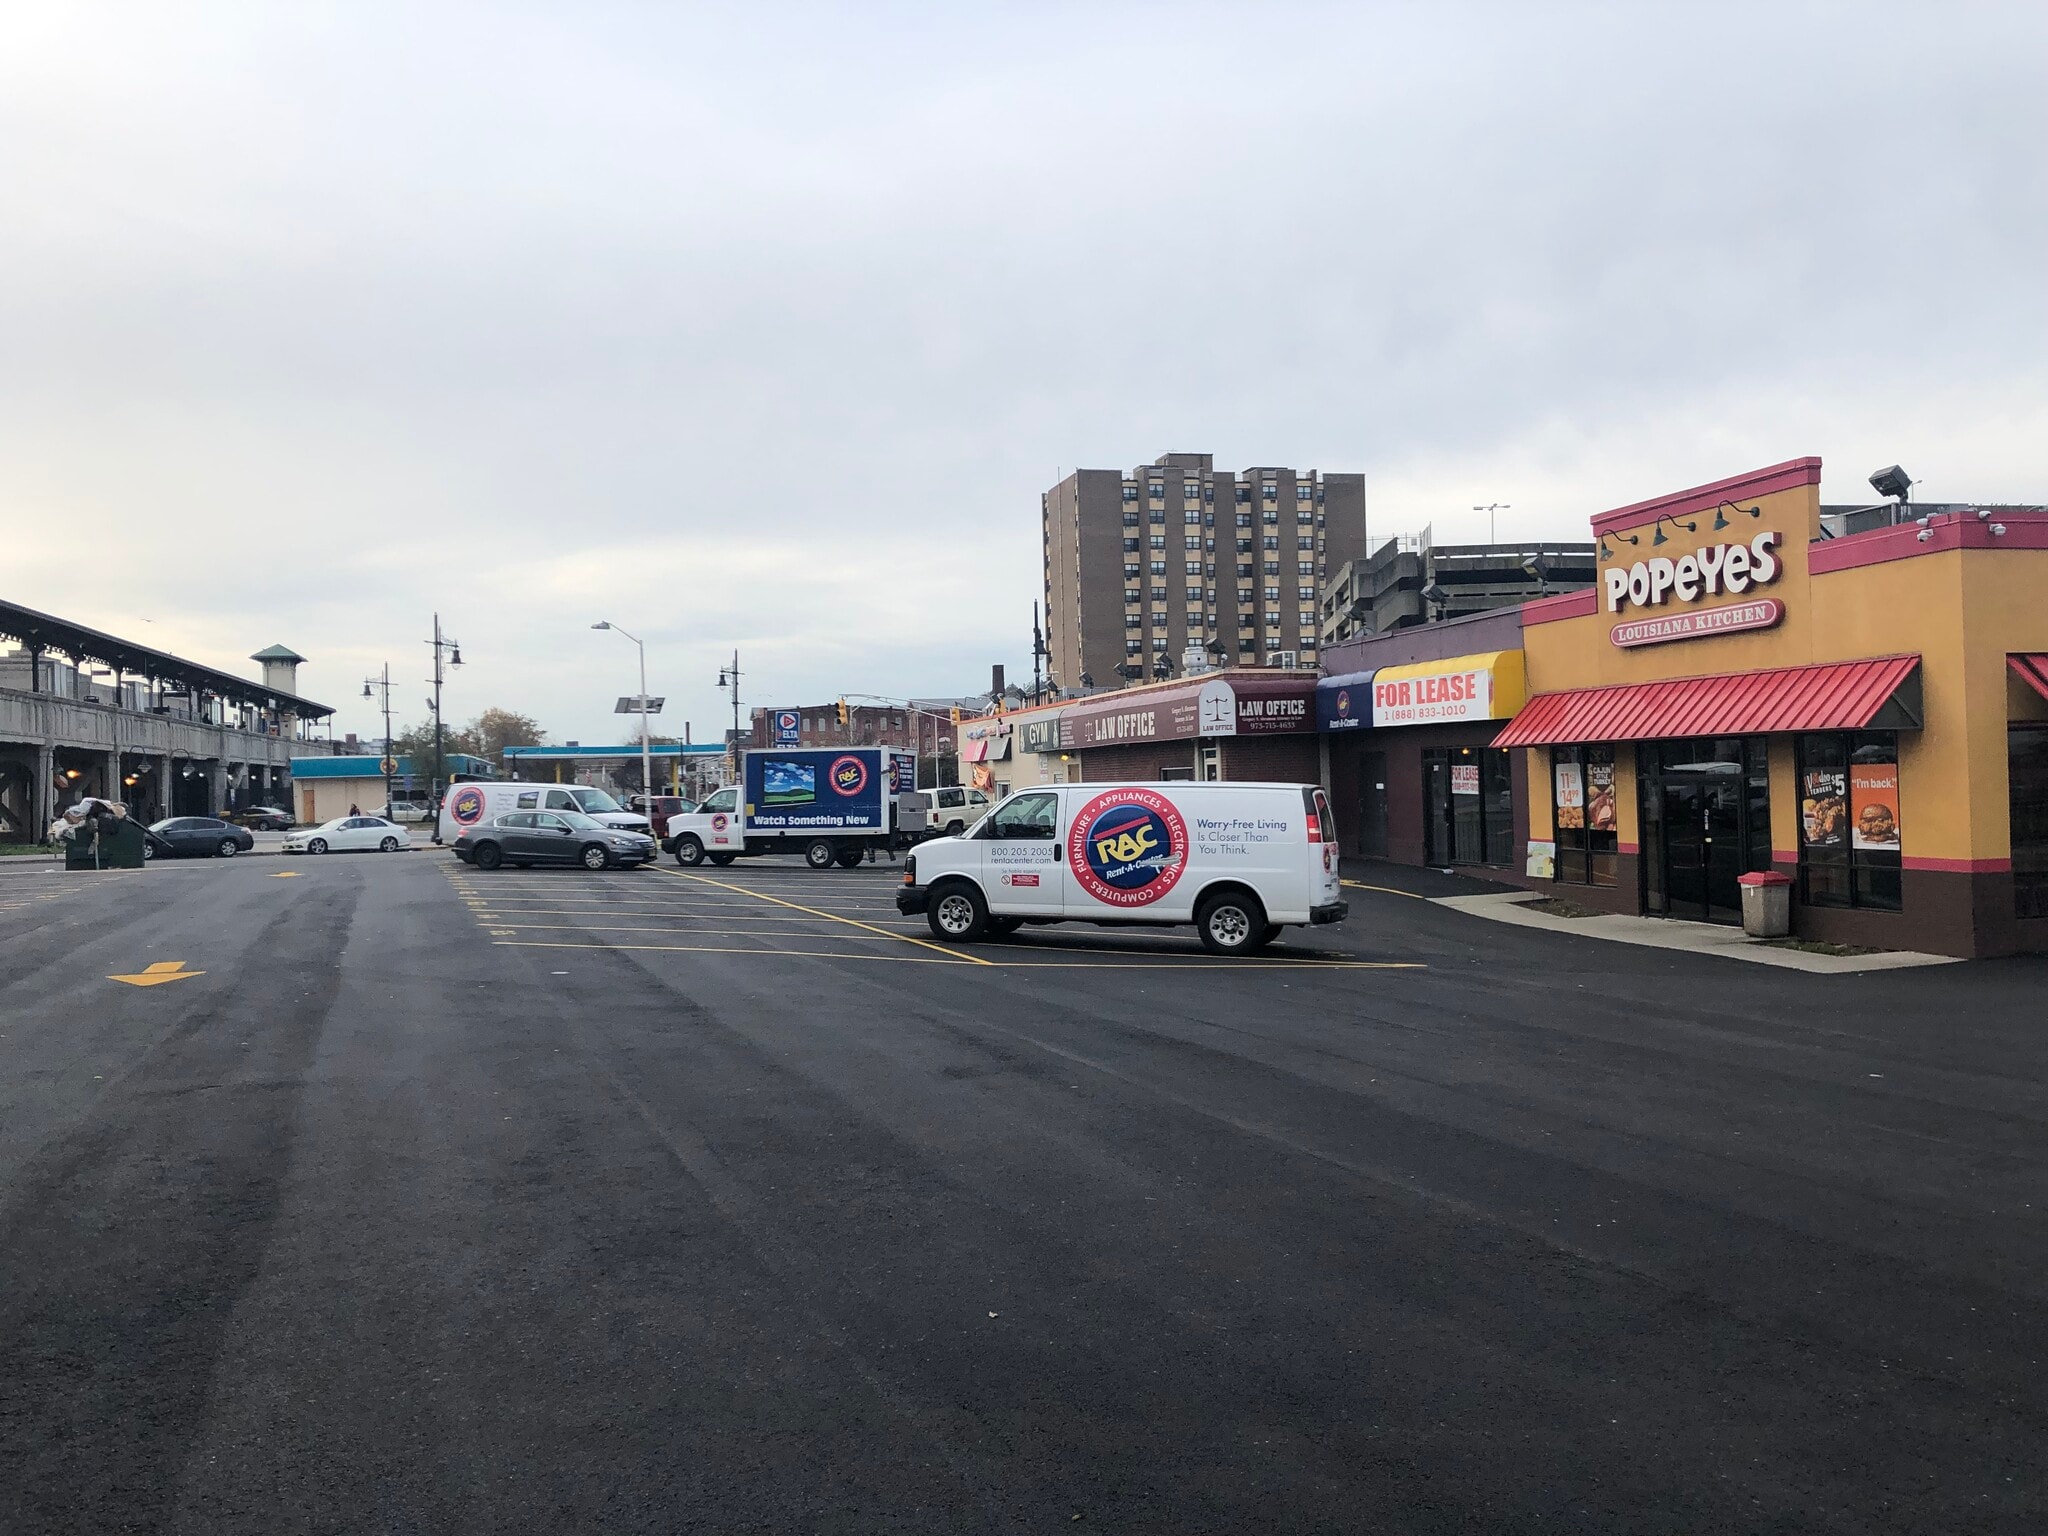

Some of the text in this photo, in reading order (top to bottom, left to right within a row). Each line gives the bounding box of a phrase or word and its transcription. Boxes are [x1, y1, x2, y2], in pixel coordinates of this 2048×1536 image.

[1617, 605, 1767, 642] LOUISIANA KITCHEN
[1375, 682, 1411, 708] FOR
[1415, 673, 1476, 705] LEASE
[1239, 699, 1306, 717] LAW OFFICE
[1384, 704, 1466, 721] 1 (888) 833-1010
[1029, 721, 1048, 745] GYM
[1095, 716, 1116, 741] LAW
[1117, 711, 1156, 739] OFFICE
[1215, 724, 1234, 732] OFFICE
[838, 768, 858, 783] RAC
[1099, 791, 1162, 810] APPLIANCES
[754, 815, 869, 827] Watch Something New
[1197, 818, 1287, 832] Worry-Free Living
[1073, 813, 1092, 874] FURNITURE
[1096, 824, 1158, 865] RAC
[1197, 831, 1269, 842] Is Closer Than
[991, 847, 1053, 856] 800.205.2005
[1199, 844, 1250, 855] You Think.
[1090, 880, 1154, 903] COMPUTERS
